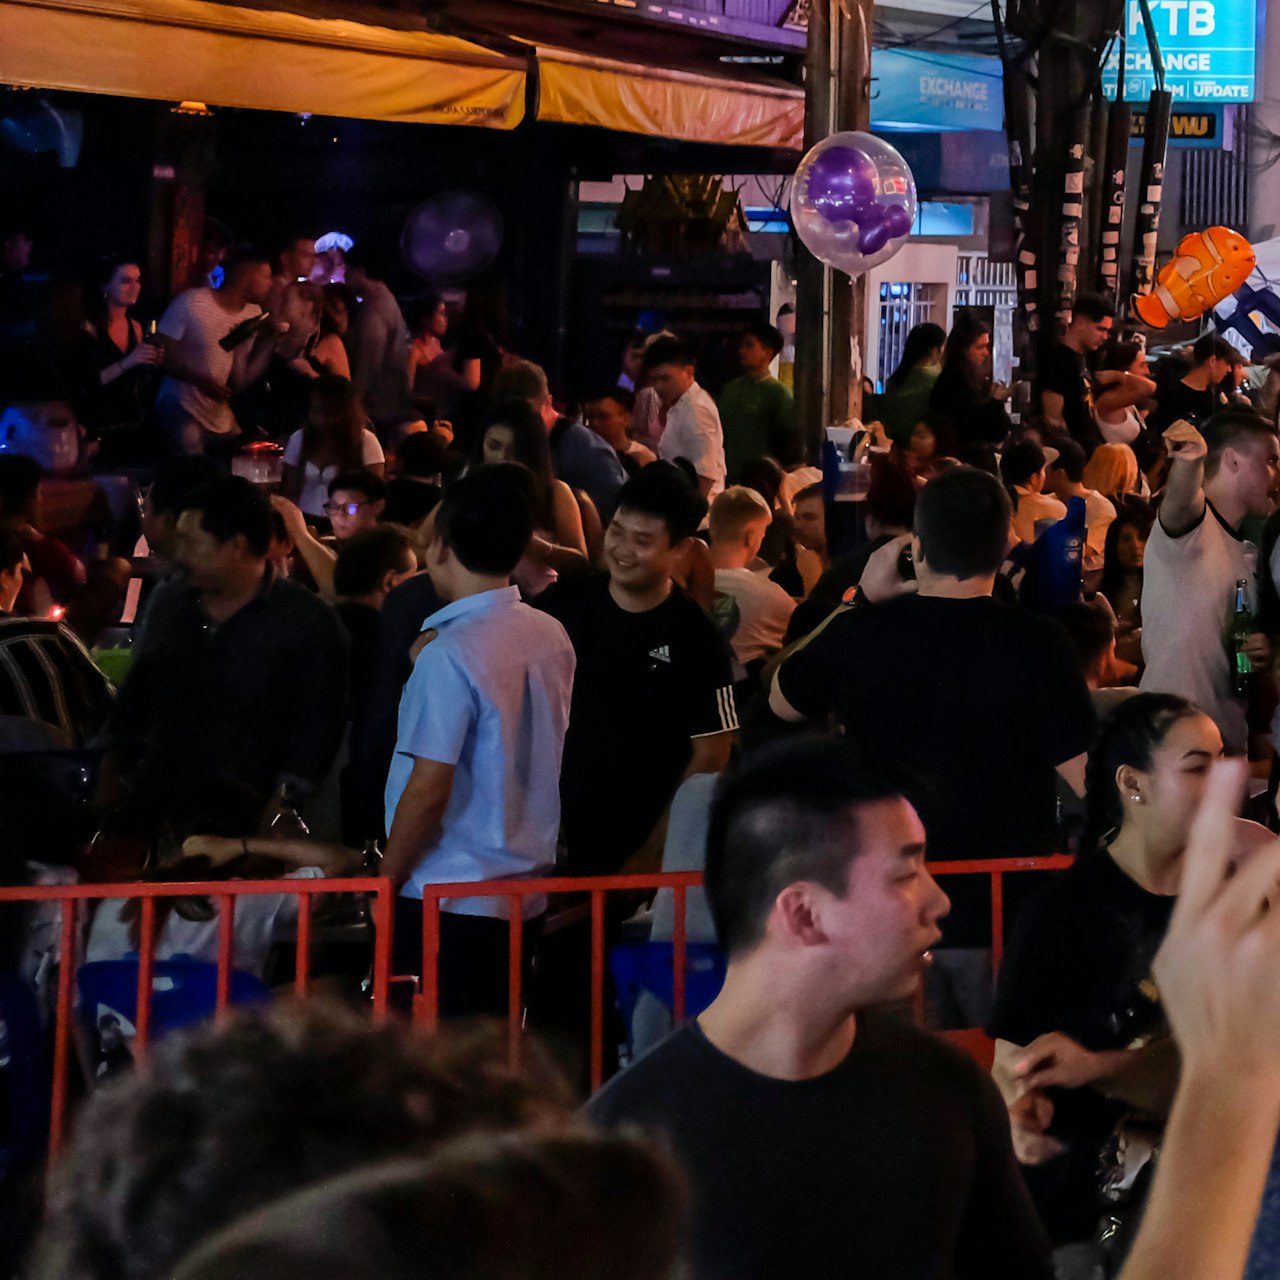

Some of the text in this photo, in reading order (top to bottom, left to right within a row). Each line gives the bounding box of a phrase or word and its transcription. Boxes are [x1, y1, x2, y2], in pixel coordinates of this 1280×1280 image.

[919, 75, 989, 101] EXCHANGE
[1193, 84, 1250, 98] UPDATE
[1171, 115, 1209, 136] WU
